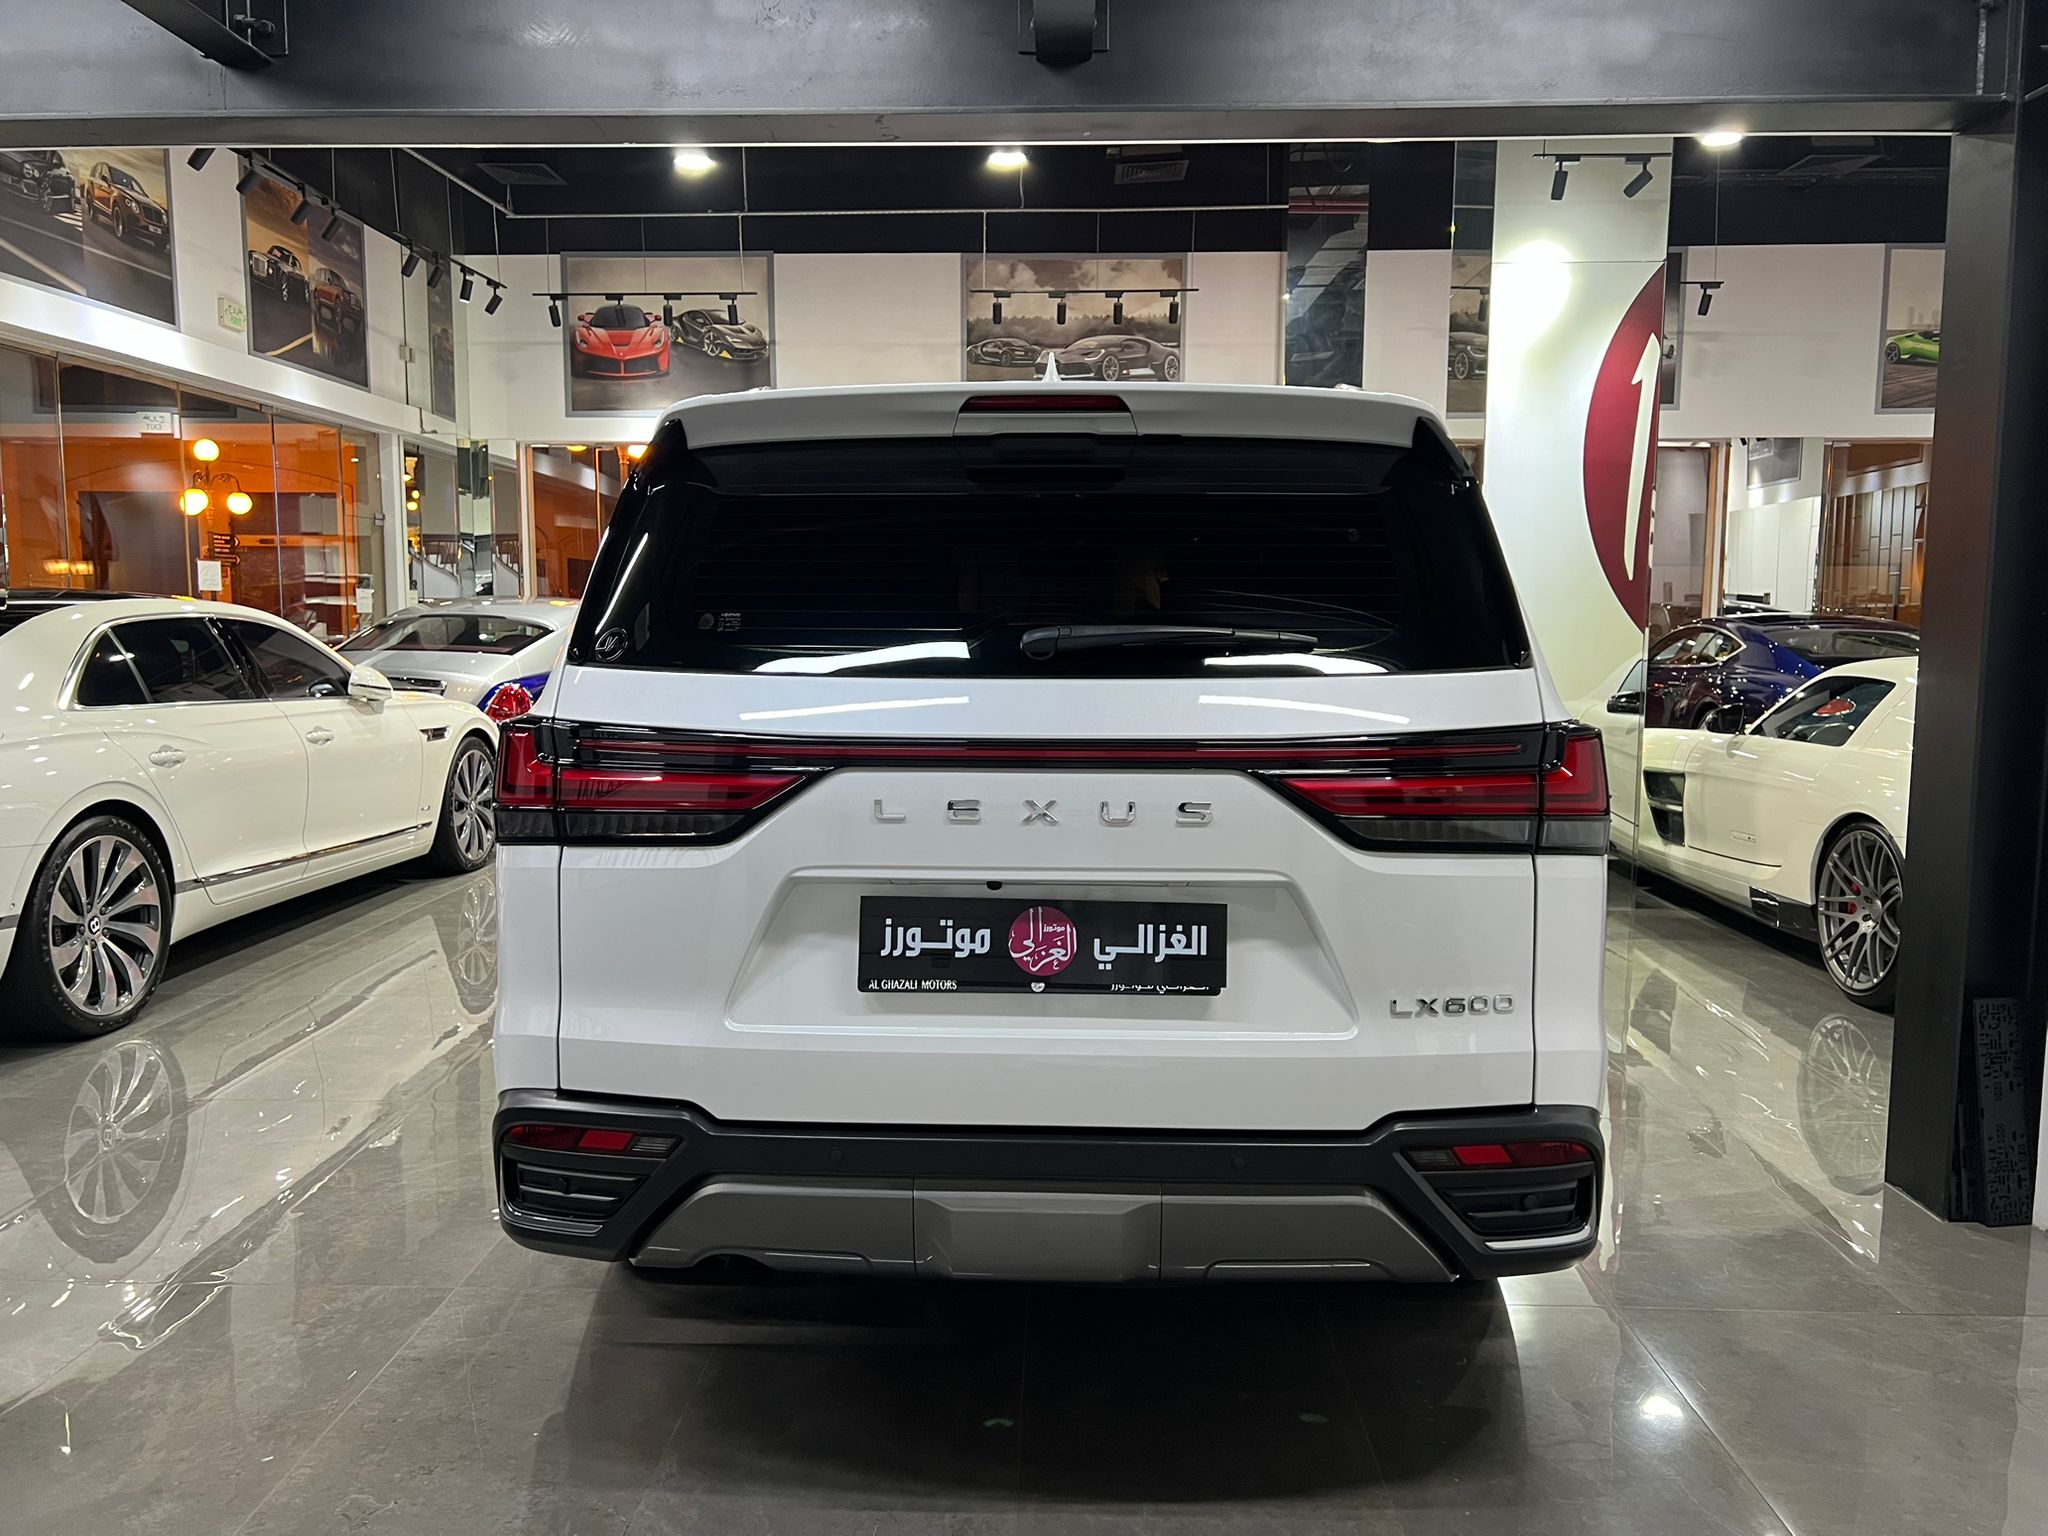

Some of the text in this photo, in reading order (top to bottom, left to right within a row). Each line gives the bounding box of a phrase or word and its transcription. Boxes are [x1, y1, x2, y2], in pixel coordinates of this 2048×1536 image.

[873, 798, 1214, 827] LEXUS
[880, 918, 1208, 970] الغزالي موتورز
[868, 979, 958, 990] AL GHAZALI MOTORS
[1389, 994, 1516, 1019] LX600
